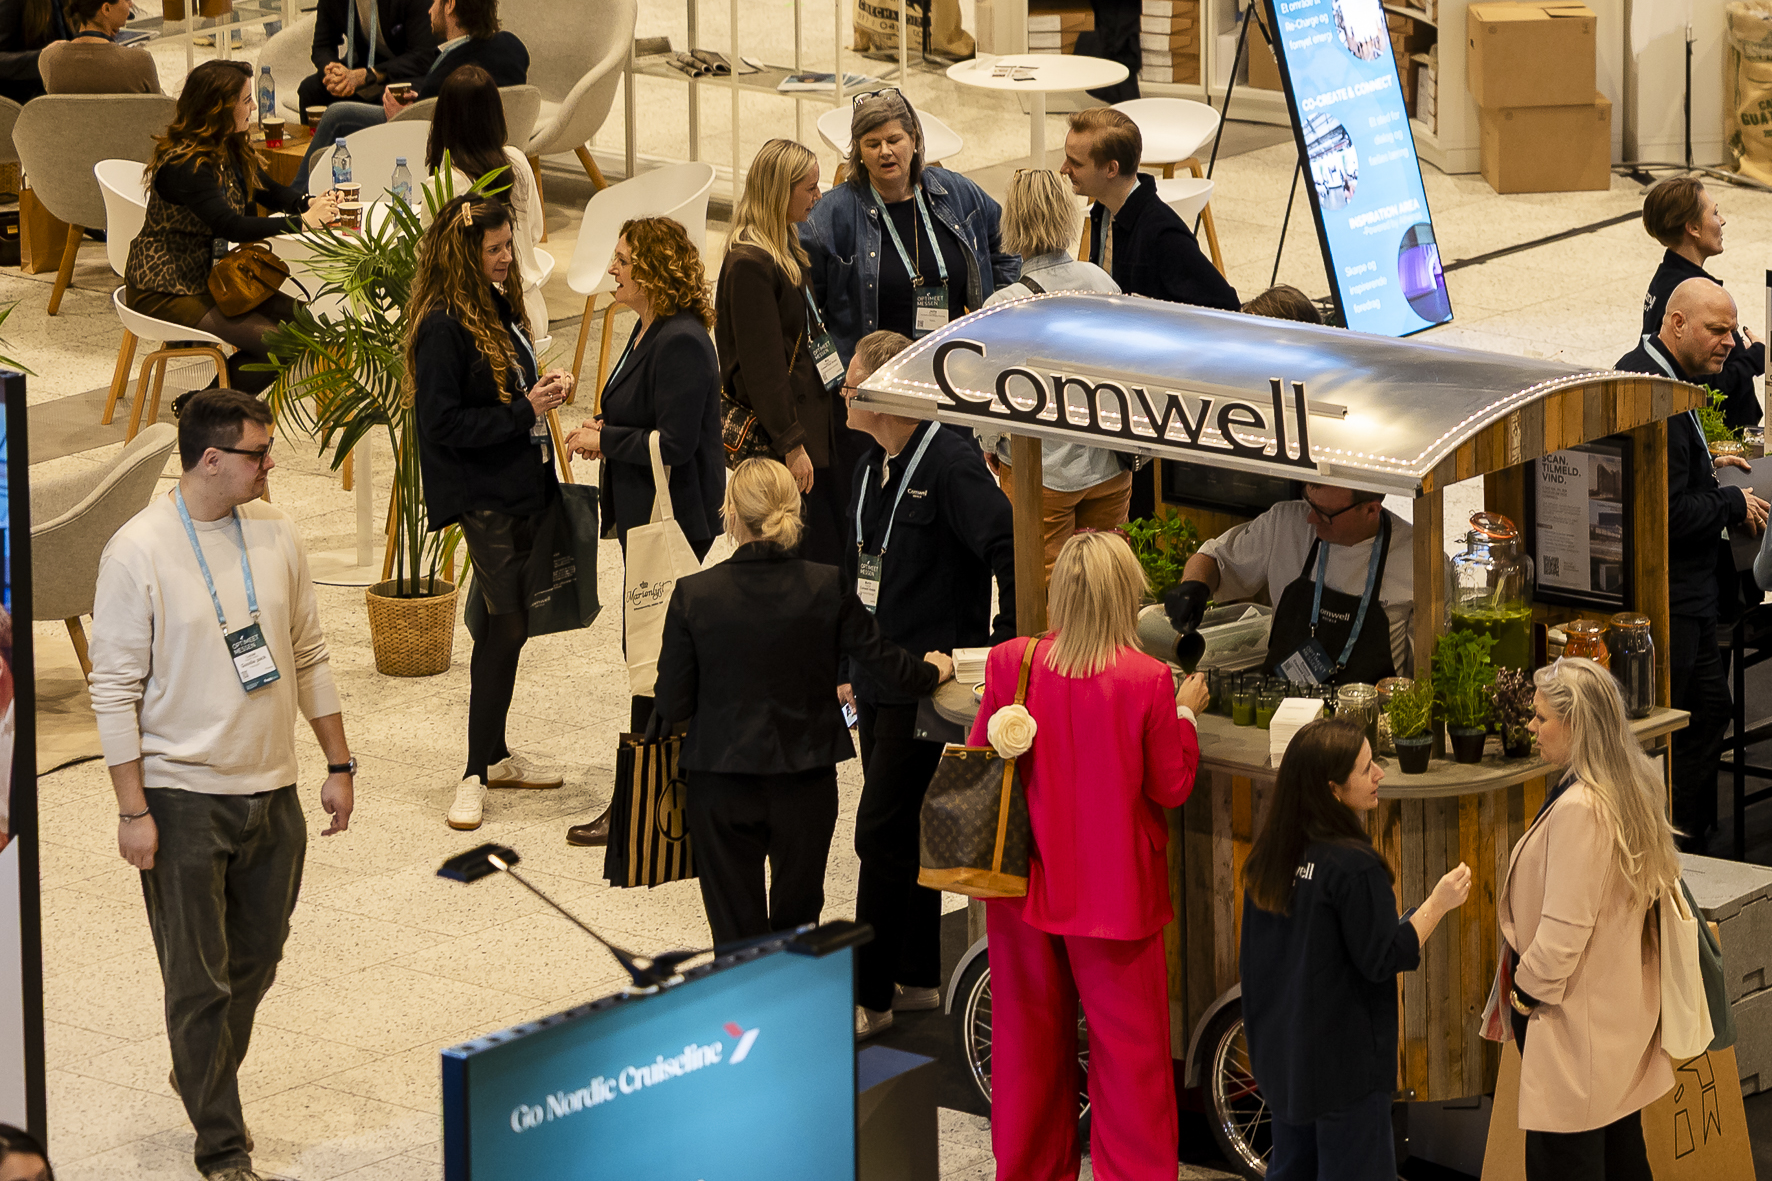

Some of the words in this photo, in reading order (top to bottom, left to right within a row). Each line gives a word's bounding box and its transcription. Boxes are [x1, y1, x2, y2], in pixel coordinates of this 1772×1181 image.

[1302, 87, 1348, 112] CO-CREATE
[1354, 74, 1393, 97] CONNECT
[1348, 202, 1399, 230] INSPIRATION
[1398, 198, 1421, 214] AREA
[932, 338, 1318, 470] Comwell
[1320, 608, 1350, 621] omwell
[510, 1104, 544, 1133] Go
[546, 1076, 617, 1122] Nordic
[619, 1041, 723, 1094] Cruiseline
